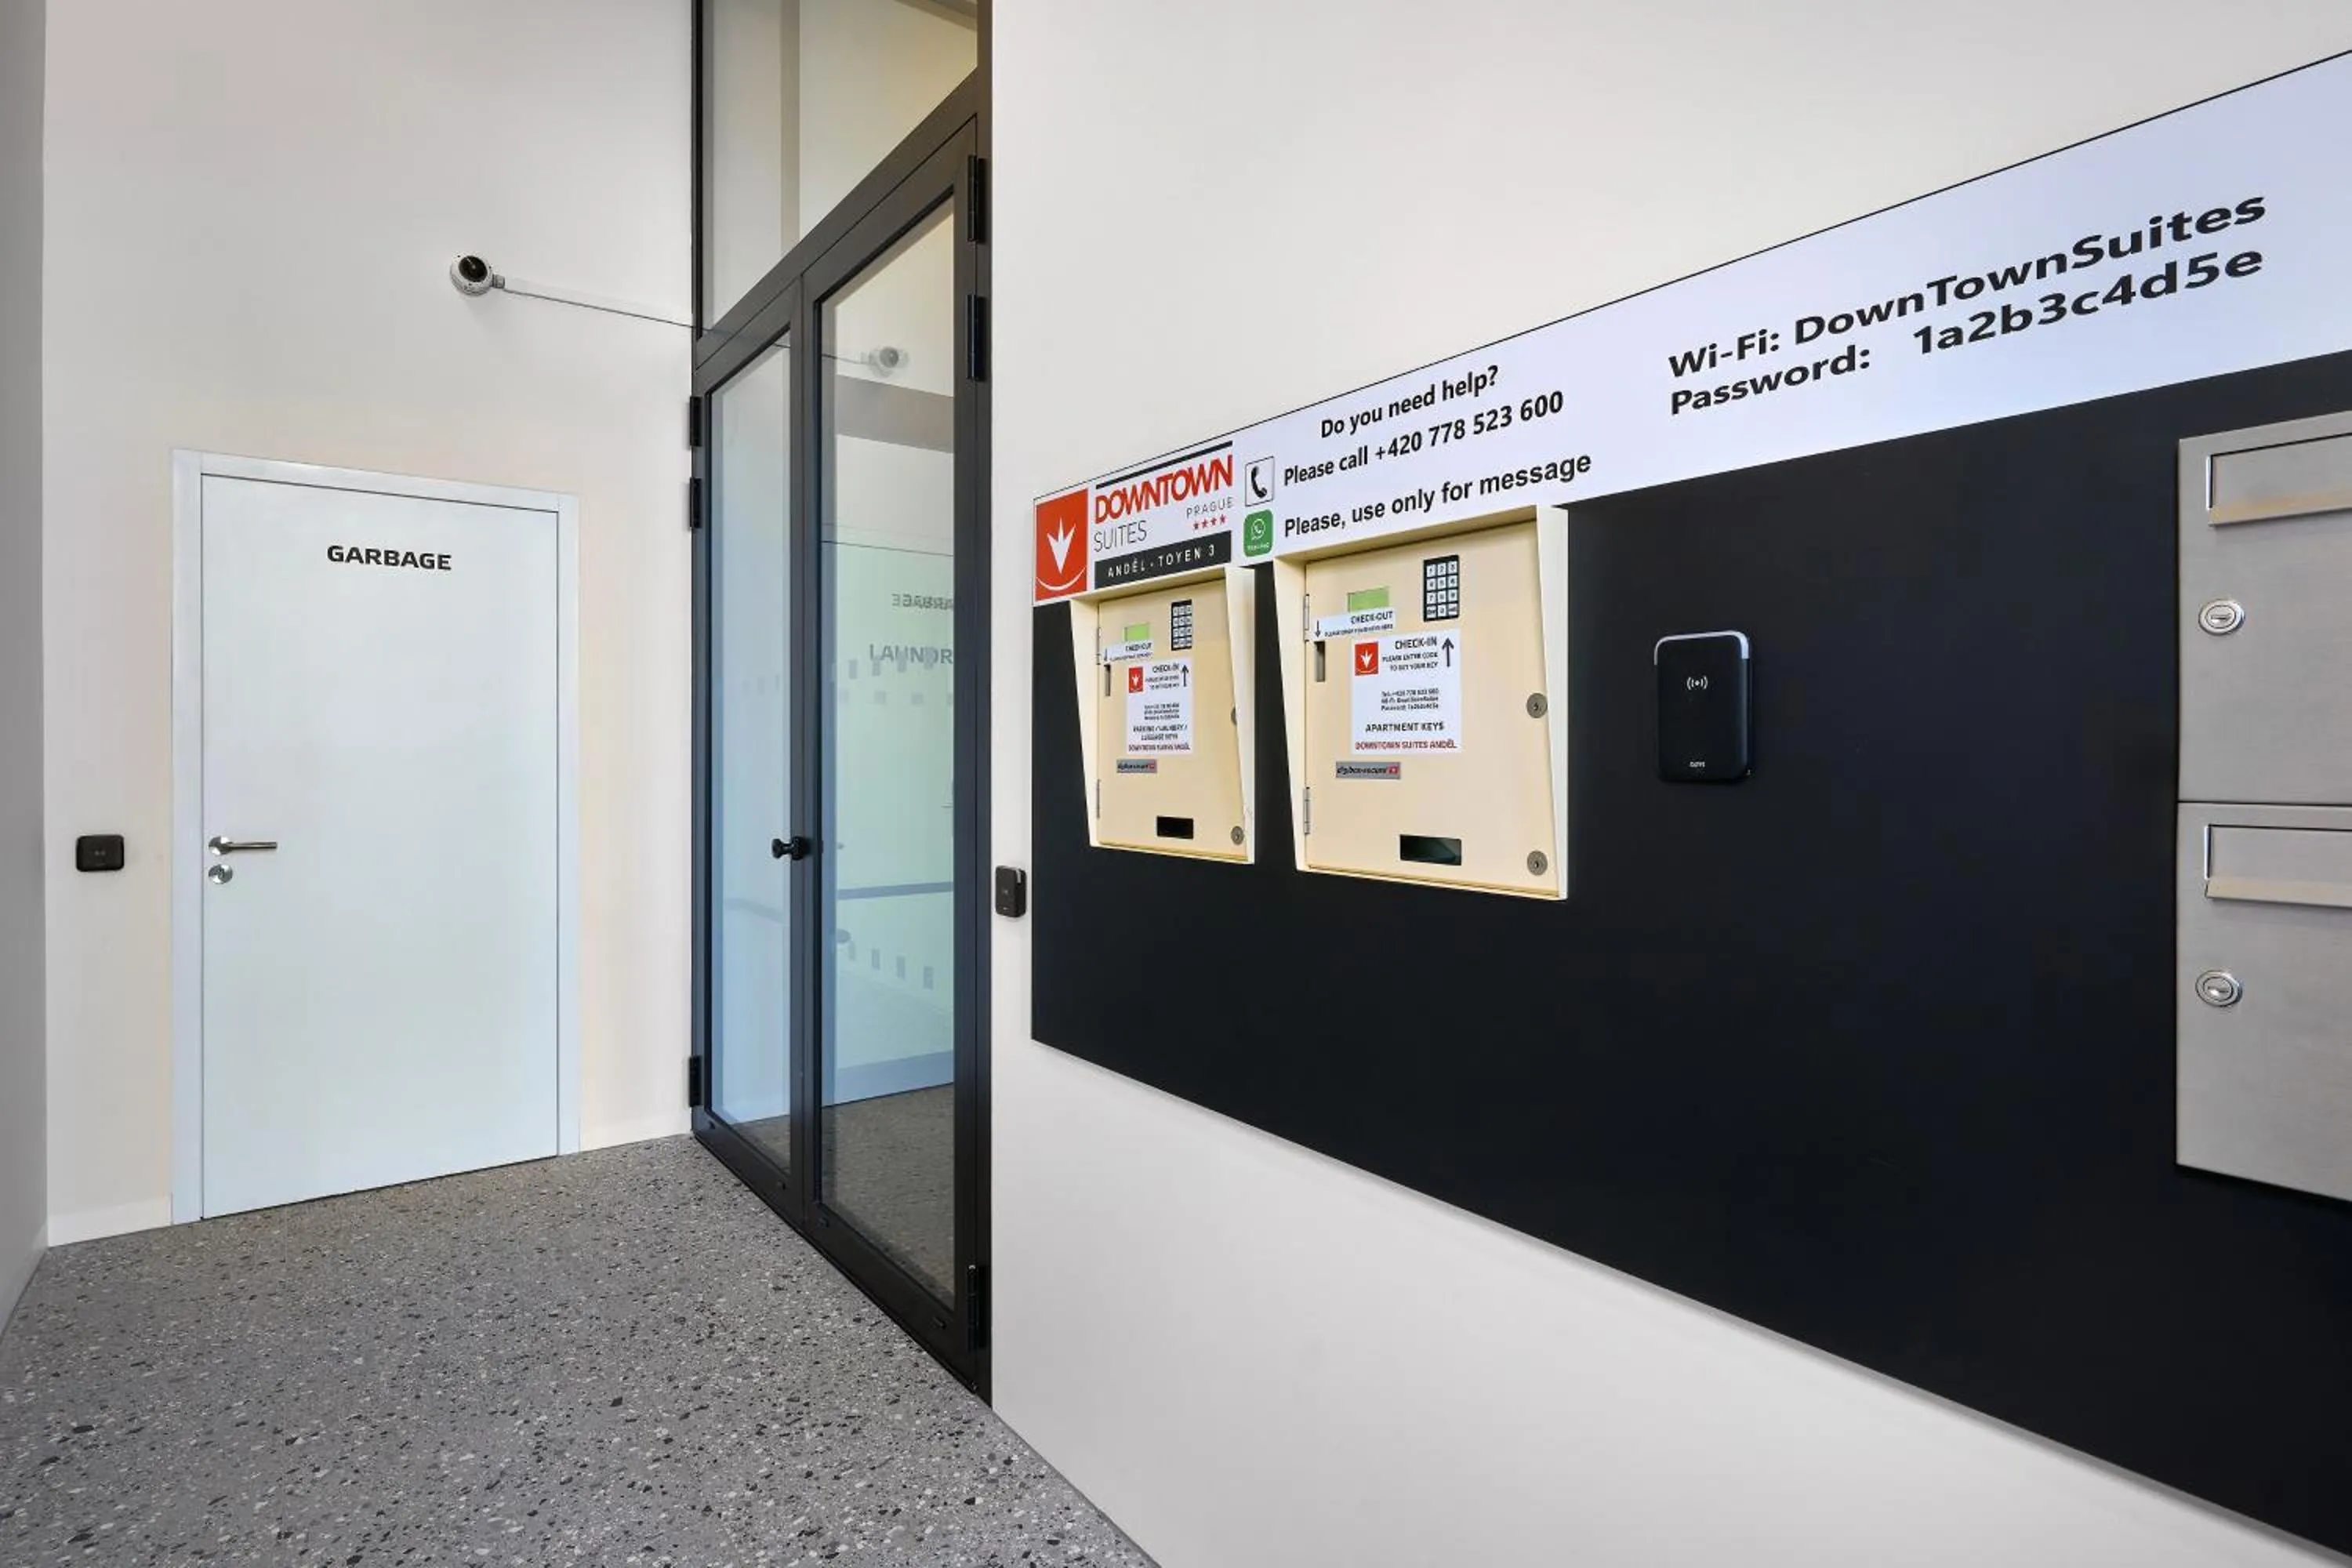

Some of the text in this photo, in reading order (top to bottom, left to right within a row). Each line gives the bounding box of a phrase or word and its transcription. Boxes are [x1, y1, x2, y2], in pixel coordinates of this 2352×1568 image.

[1668, 195, 2267, 378] Wi-Fi: DownTownSuites
[1671, 249, 2263, 415] Password: 1a2b3c4d5e
[1321, 365, 1498, 438] Do you need help?
[1284, 390, 1564, 486] Please call +420 778 523 600
[1094, 454, 1233, 524] DOWNTOWN
[1285, 455, 1592, 538] Please, use only for message
[1186, 496, 1233, 519] PRAGUE
[1094, 520, 1147, 553] SUITES
[327, 545, 452, 571] GARBAGE
[1158, 547, 1201, 567] TOYEN
[1208, 543, 1215, 557] 3
[1395, 636, 1437, 650] CHECK-IN
[1366, 720, 1444, 732] APARTMENT KEYS
[1402, 740, 1428, 749] SUITES
